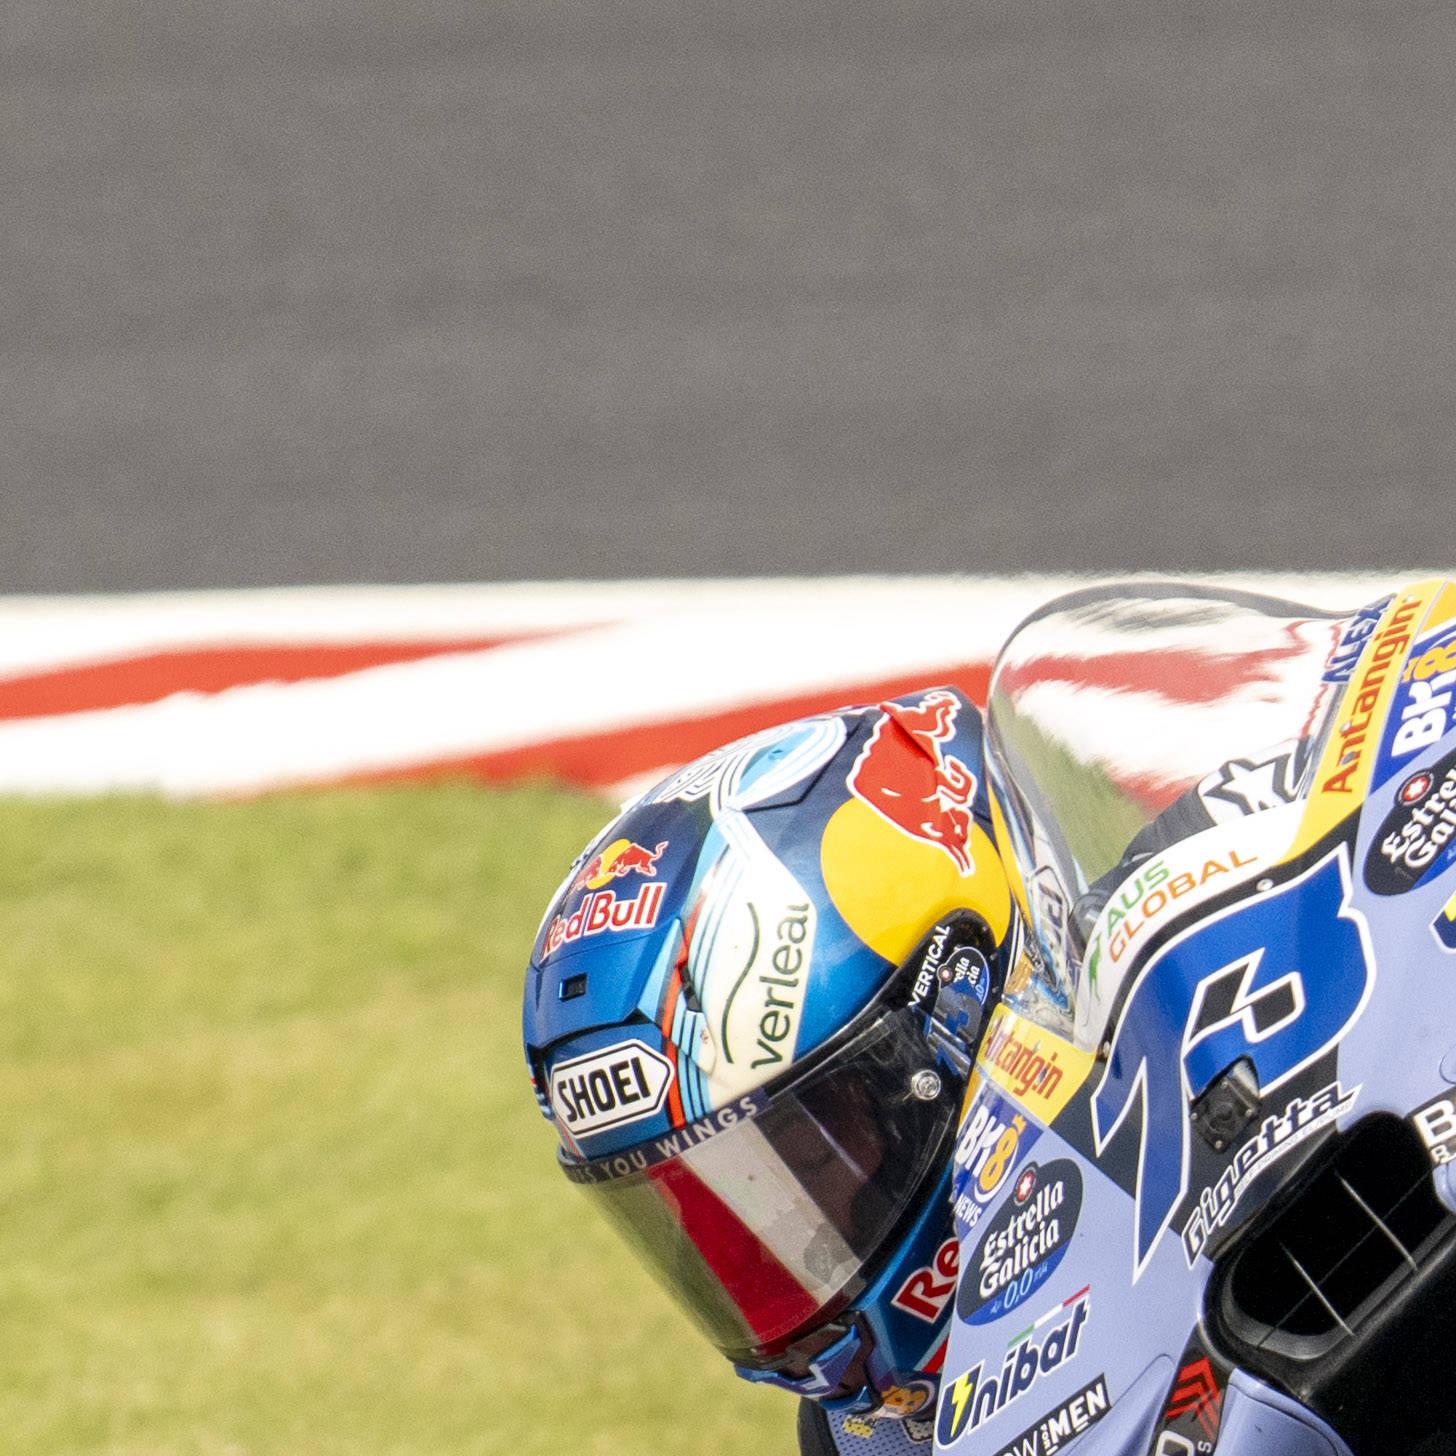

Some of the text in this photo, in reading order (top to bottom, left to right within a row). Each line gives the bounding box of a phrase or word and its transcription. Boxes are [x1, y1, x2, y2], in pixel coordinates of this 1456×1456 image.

[1322, 599, 1423, 794] Antangin
[540, 882, 667, 962] Red Bull
[1106, 860, 1170, 936] AUS
[1109, 850, 1258, 963] GLOBAL
[908, 924, 951, 1007] VERTICAL
[557, 1057, 651, 1123] SHOEI
[601, 1096, 759, 1179] YOU WINGS
[954, 1193, 983, 1227] NEWS
[980, 1181, 1064, 1271] Estrella
[891, 1237, 960, 1324] Re
[979, 1219, 1060, 1298] Galicia
[936, 1295, 1091, 1449] Unibat
[1049, 1383, 1106, 1443] MEN
